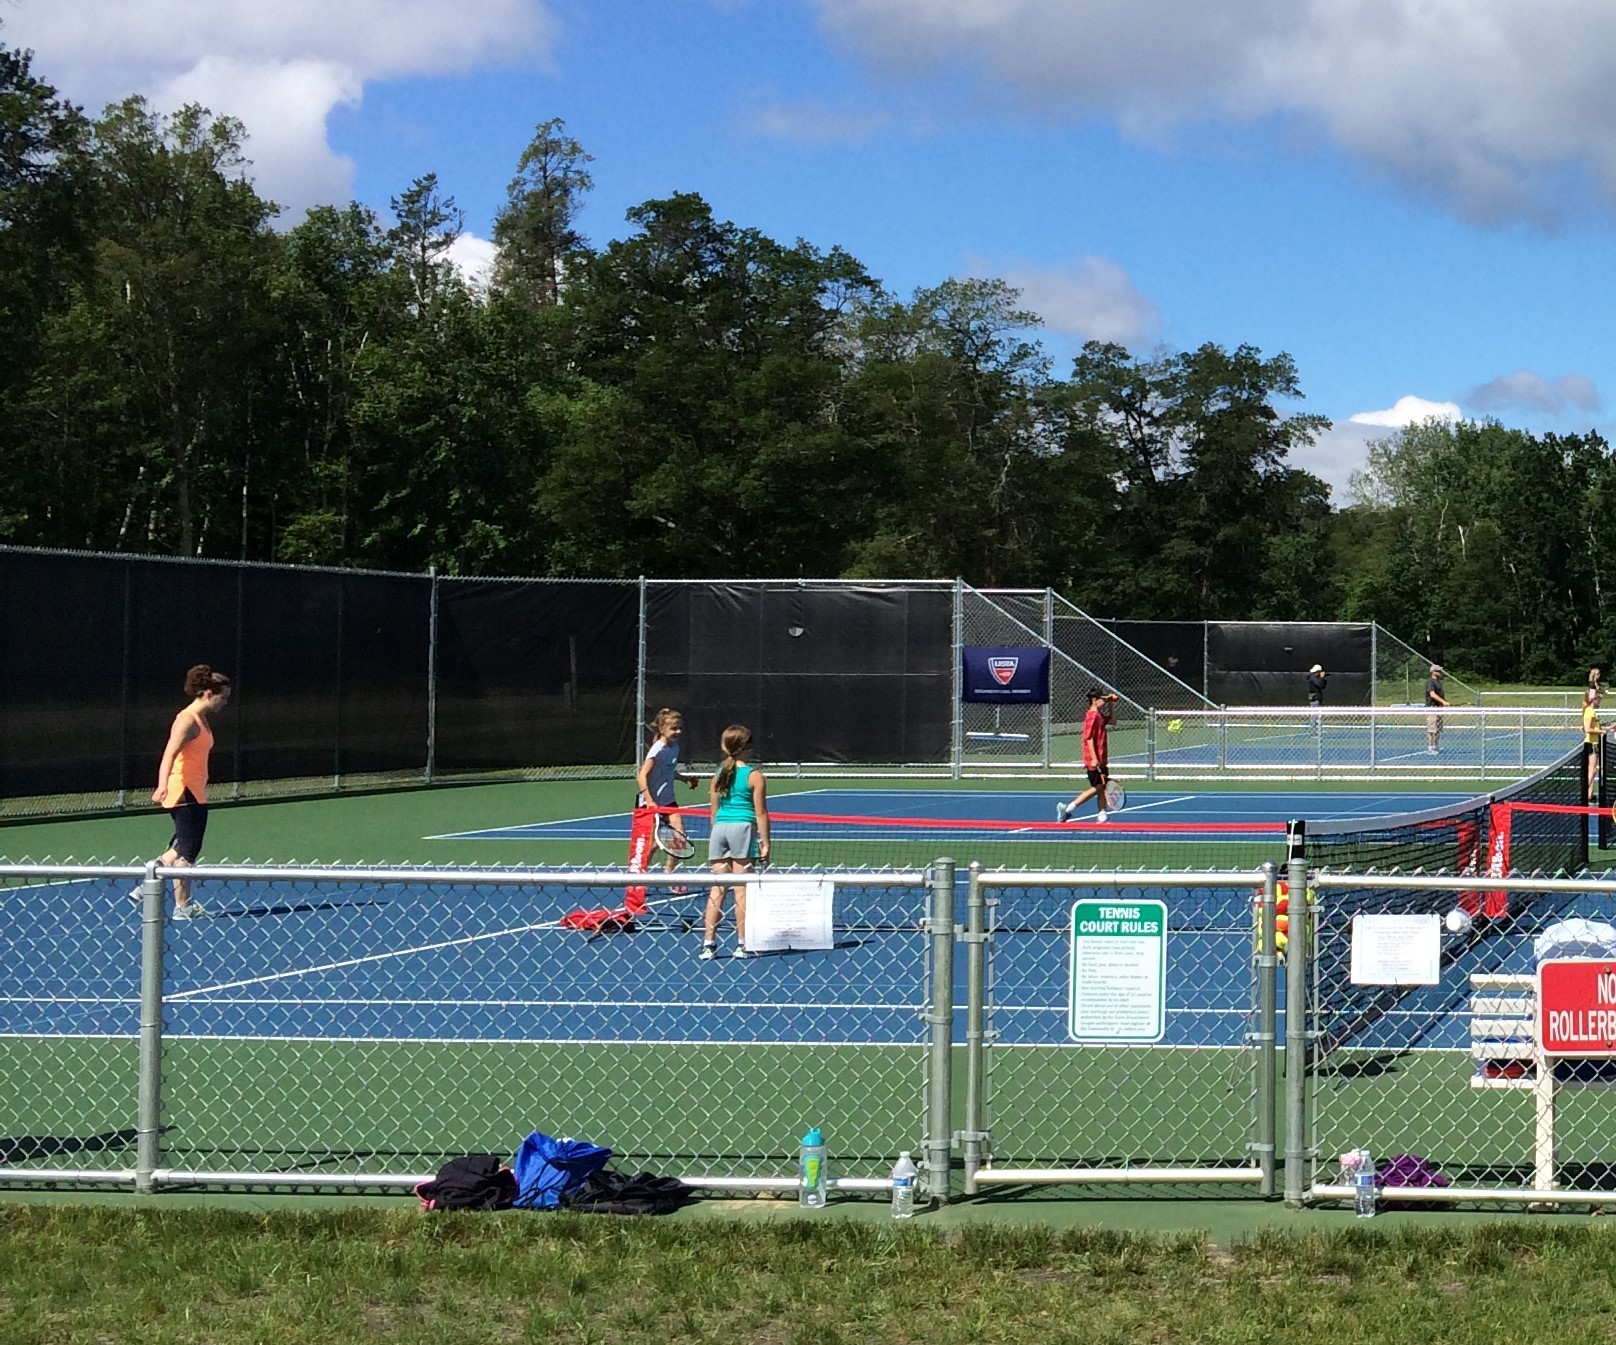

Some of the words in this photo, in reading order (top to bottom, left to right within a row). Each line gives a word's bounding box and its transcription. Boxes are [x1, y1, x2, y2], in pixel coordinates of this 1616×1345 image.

[1098, 907, 1140, 919] TENNIS
[1079, 920, 1120, 933] COURT
[1121, 921, 1159, 933] RULES
